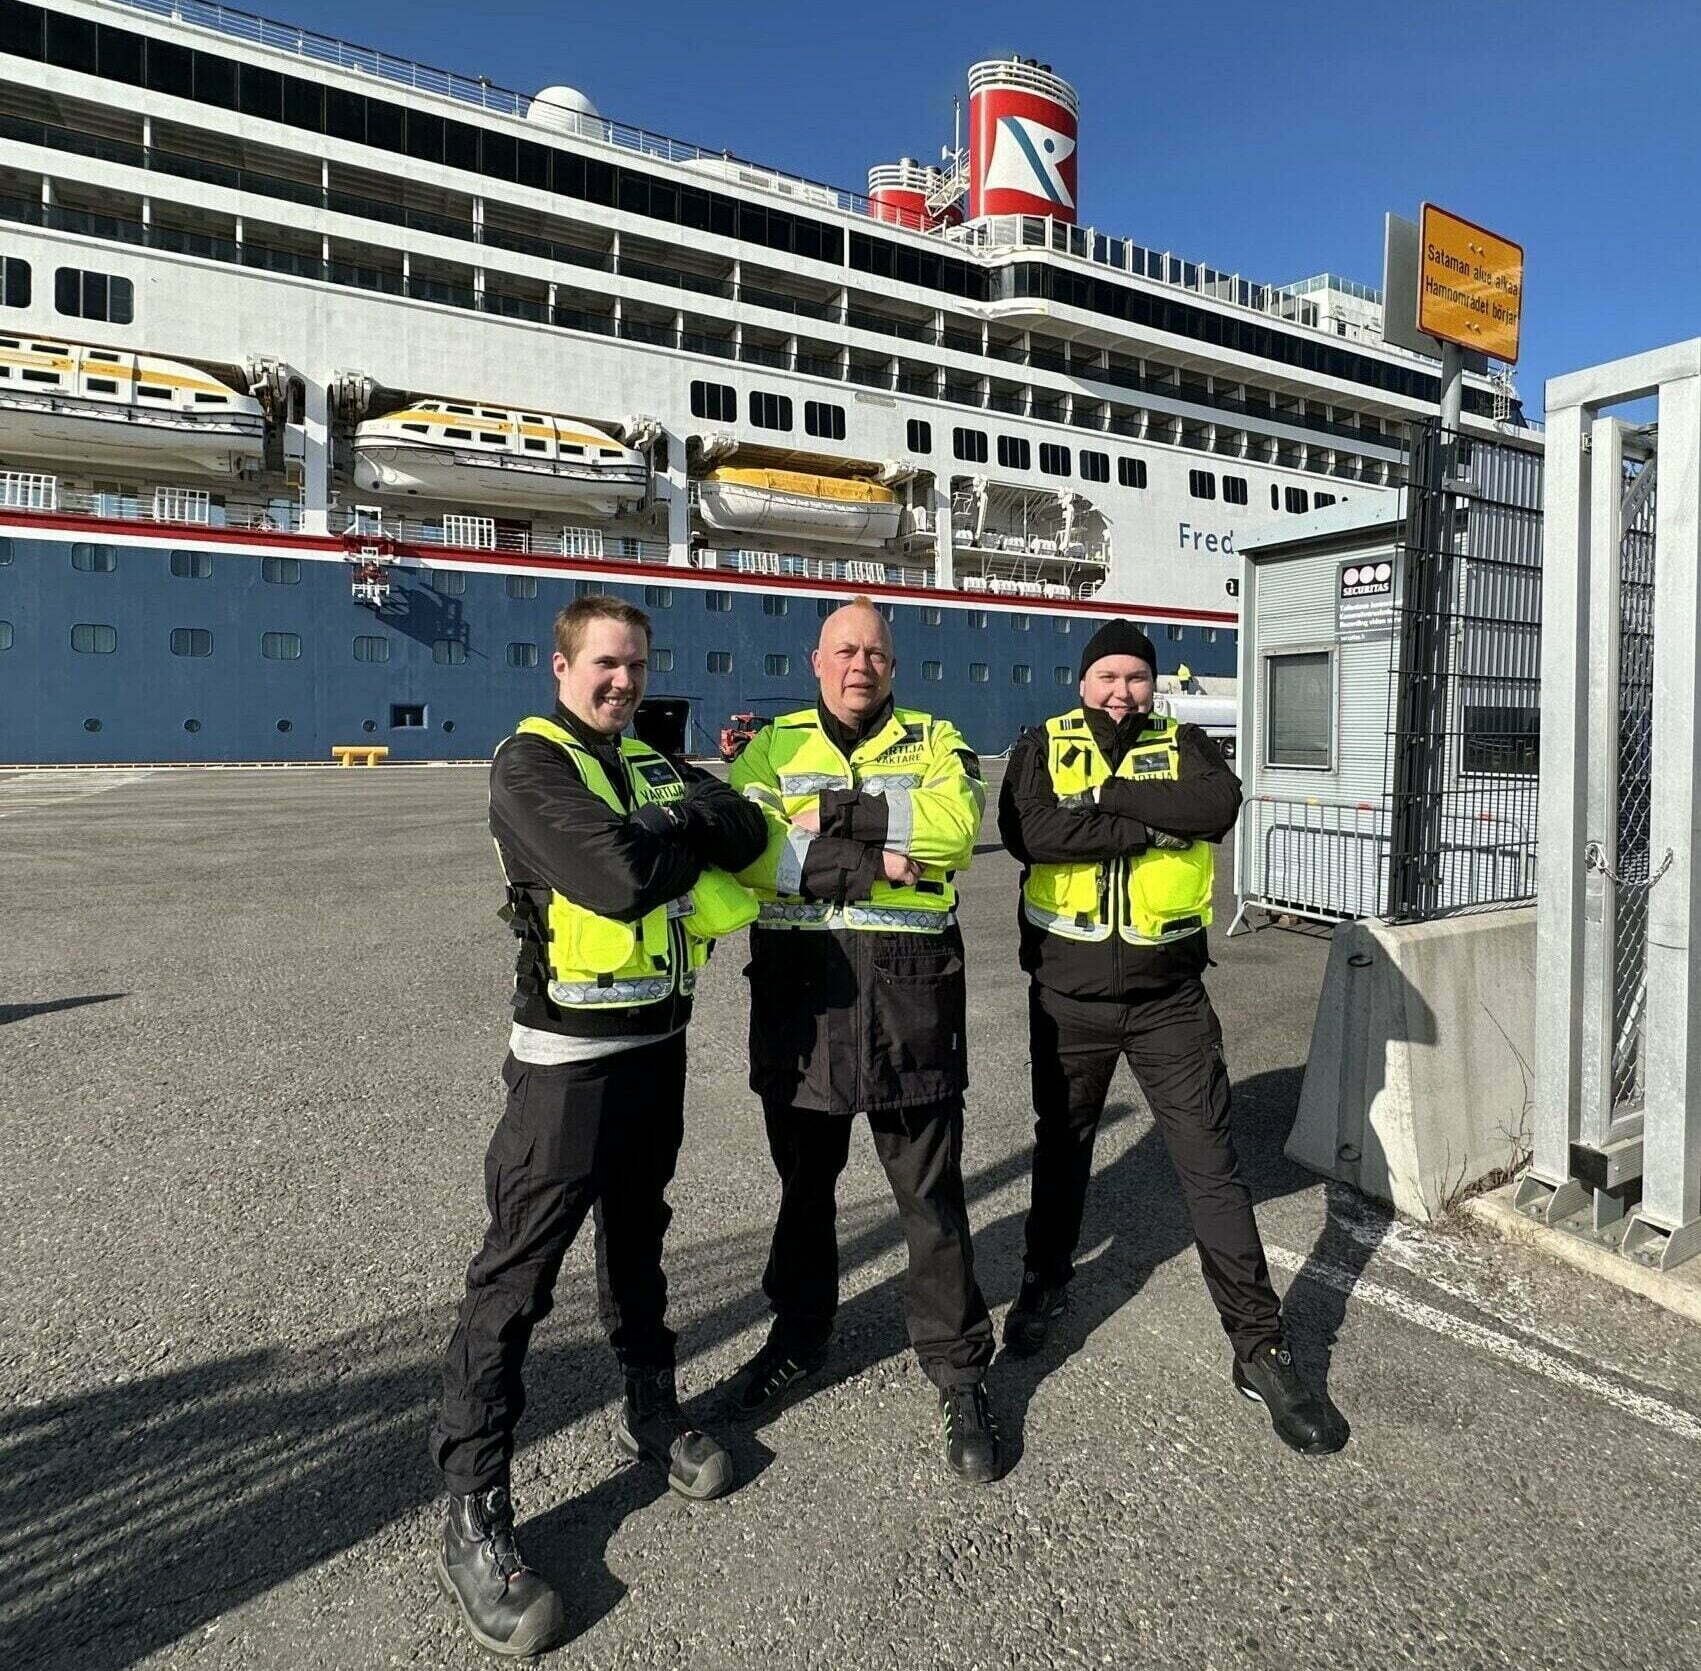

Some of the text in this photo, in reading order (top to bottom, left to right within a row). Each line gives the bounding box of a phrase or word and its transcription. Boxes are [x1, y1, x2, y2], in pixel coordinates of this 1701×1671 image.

[1428, 244, 1518, 296] Sataman alue alkaa
[1179, 522, 1234, 554] Fred
[1343, 582, 1390, 596] SECURITAS
[640, 784, 685, 800] VARTIJA
